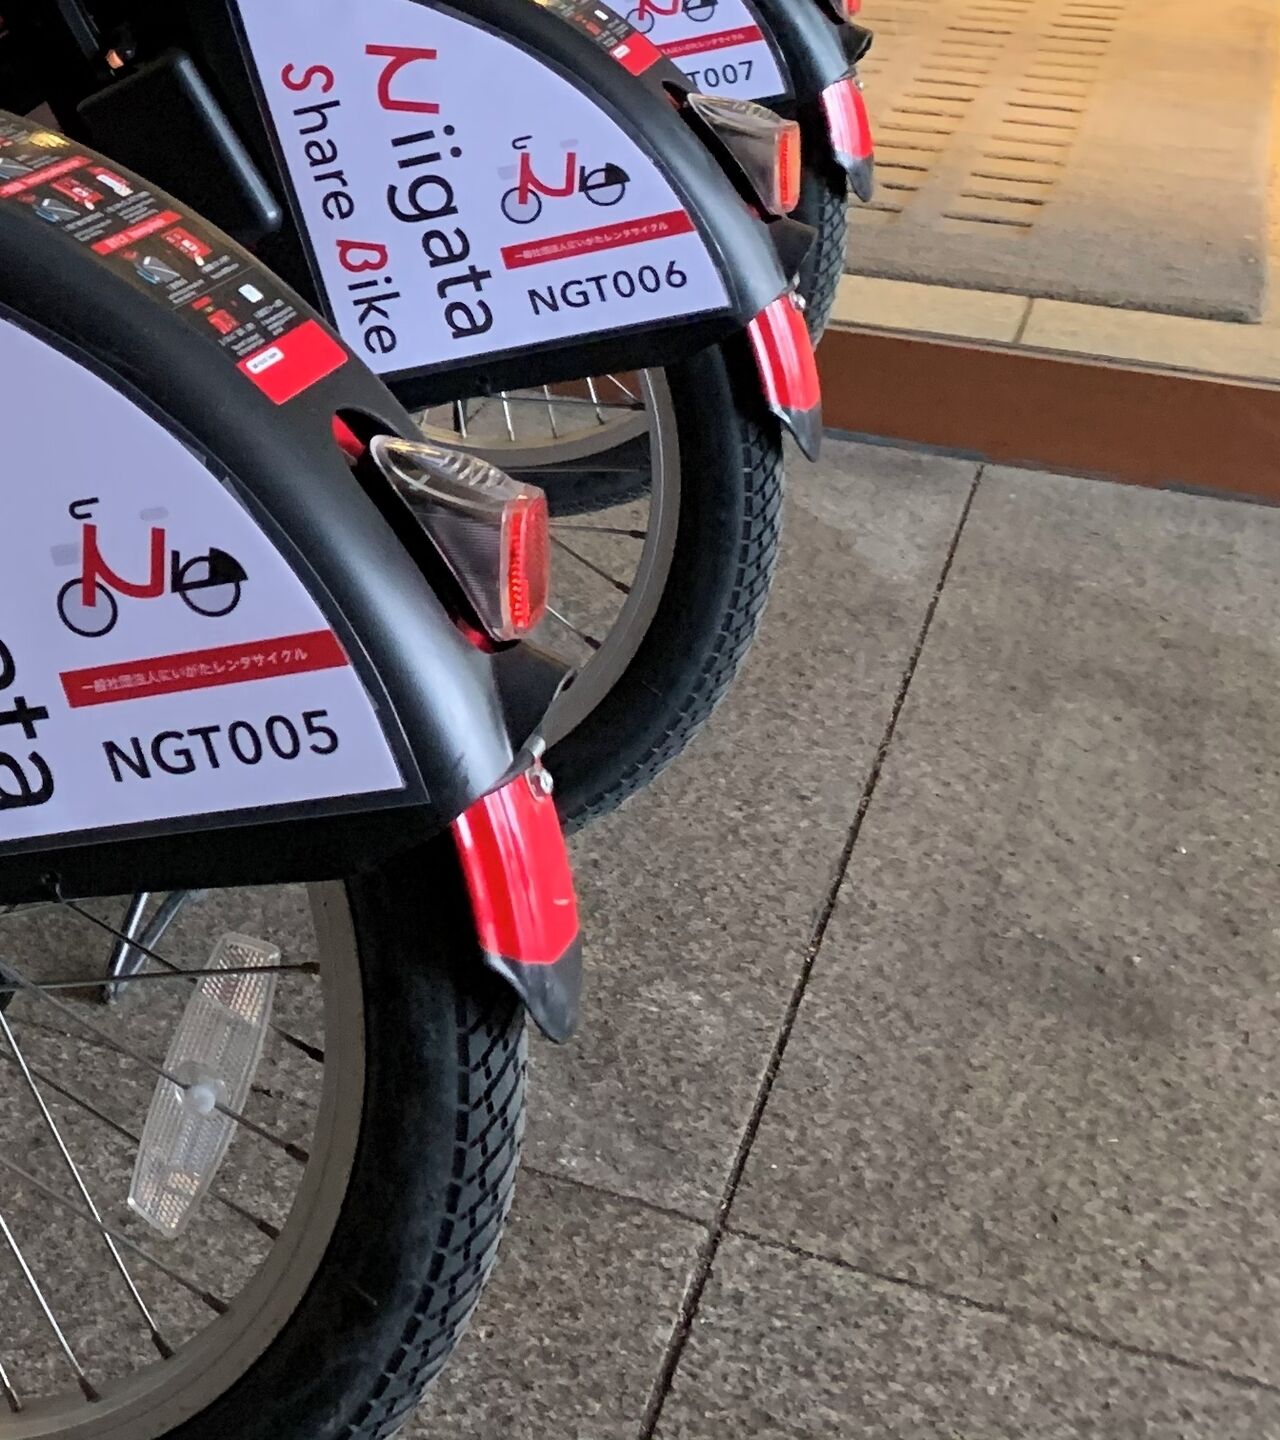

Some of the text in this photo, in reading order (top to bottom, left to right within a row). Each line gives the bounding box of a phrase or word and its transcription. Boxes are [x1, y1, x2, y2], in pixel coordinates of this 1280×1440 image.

[685, 60, 754, 88] T007
[280, 63, 399, 357] Share Bike
[365, 44, 495, 341] Niigata
[527, 260, 688, 316] NGT006
[102, 709, 339, 783] NGT005
